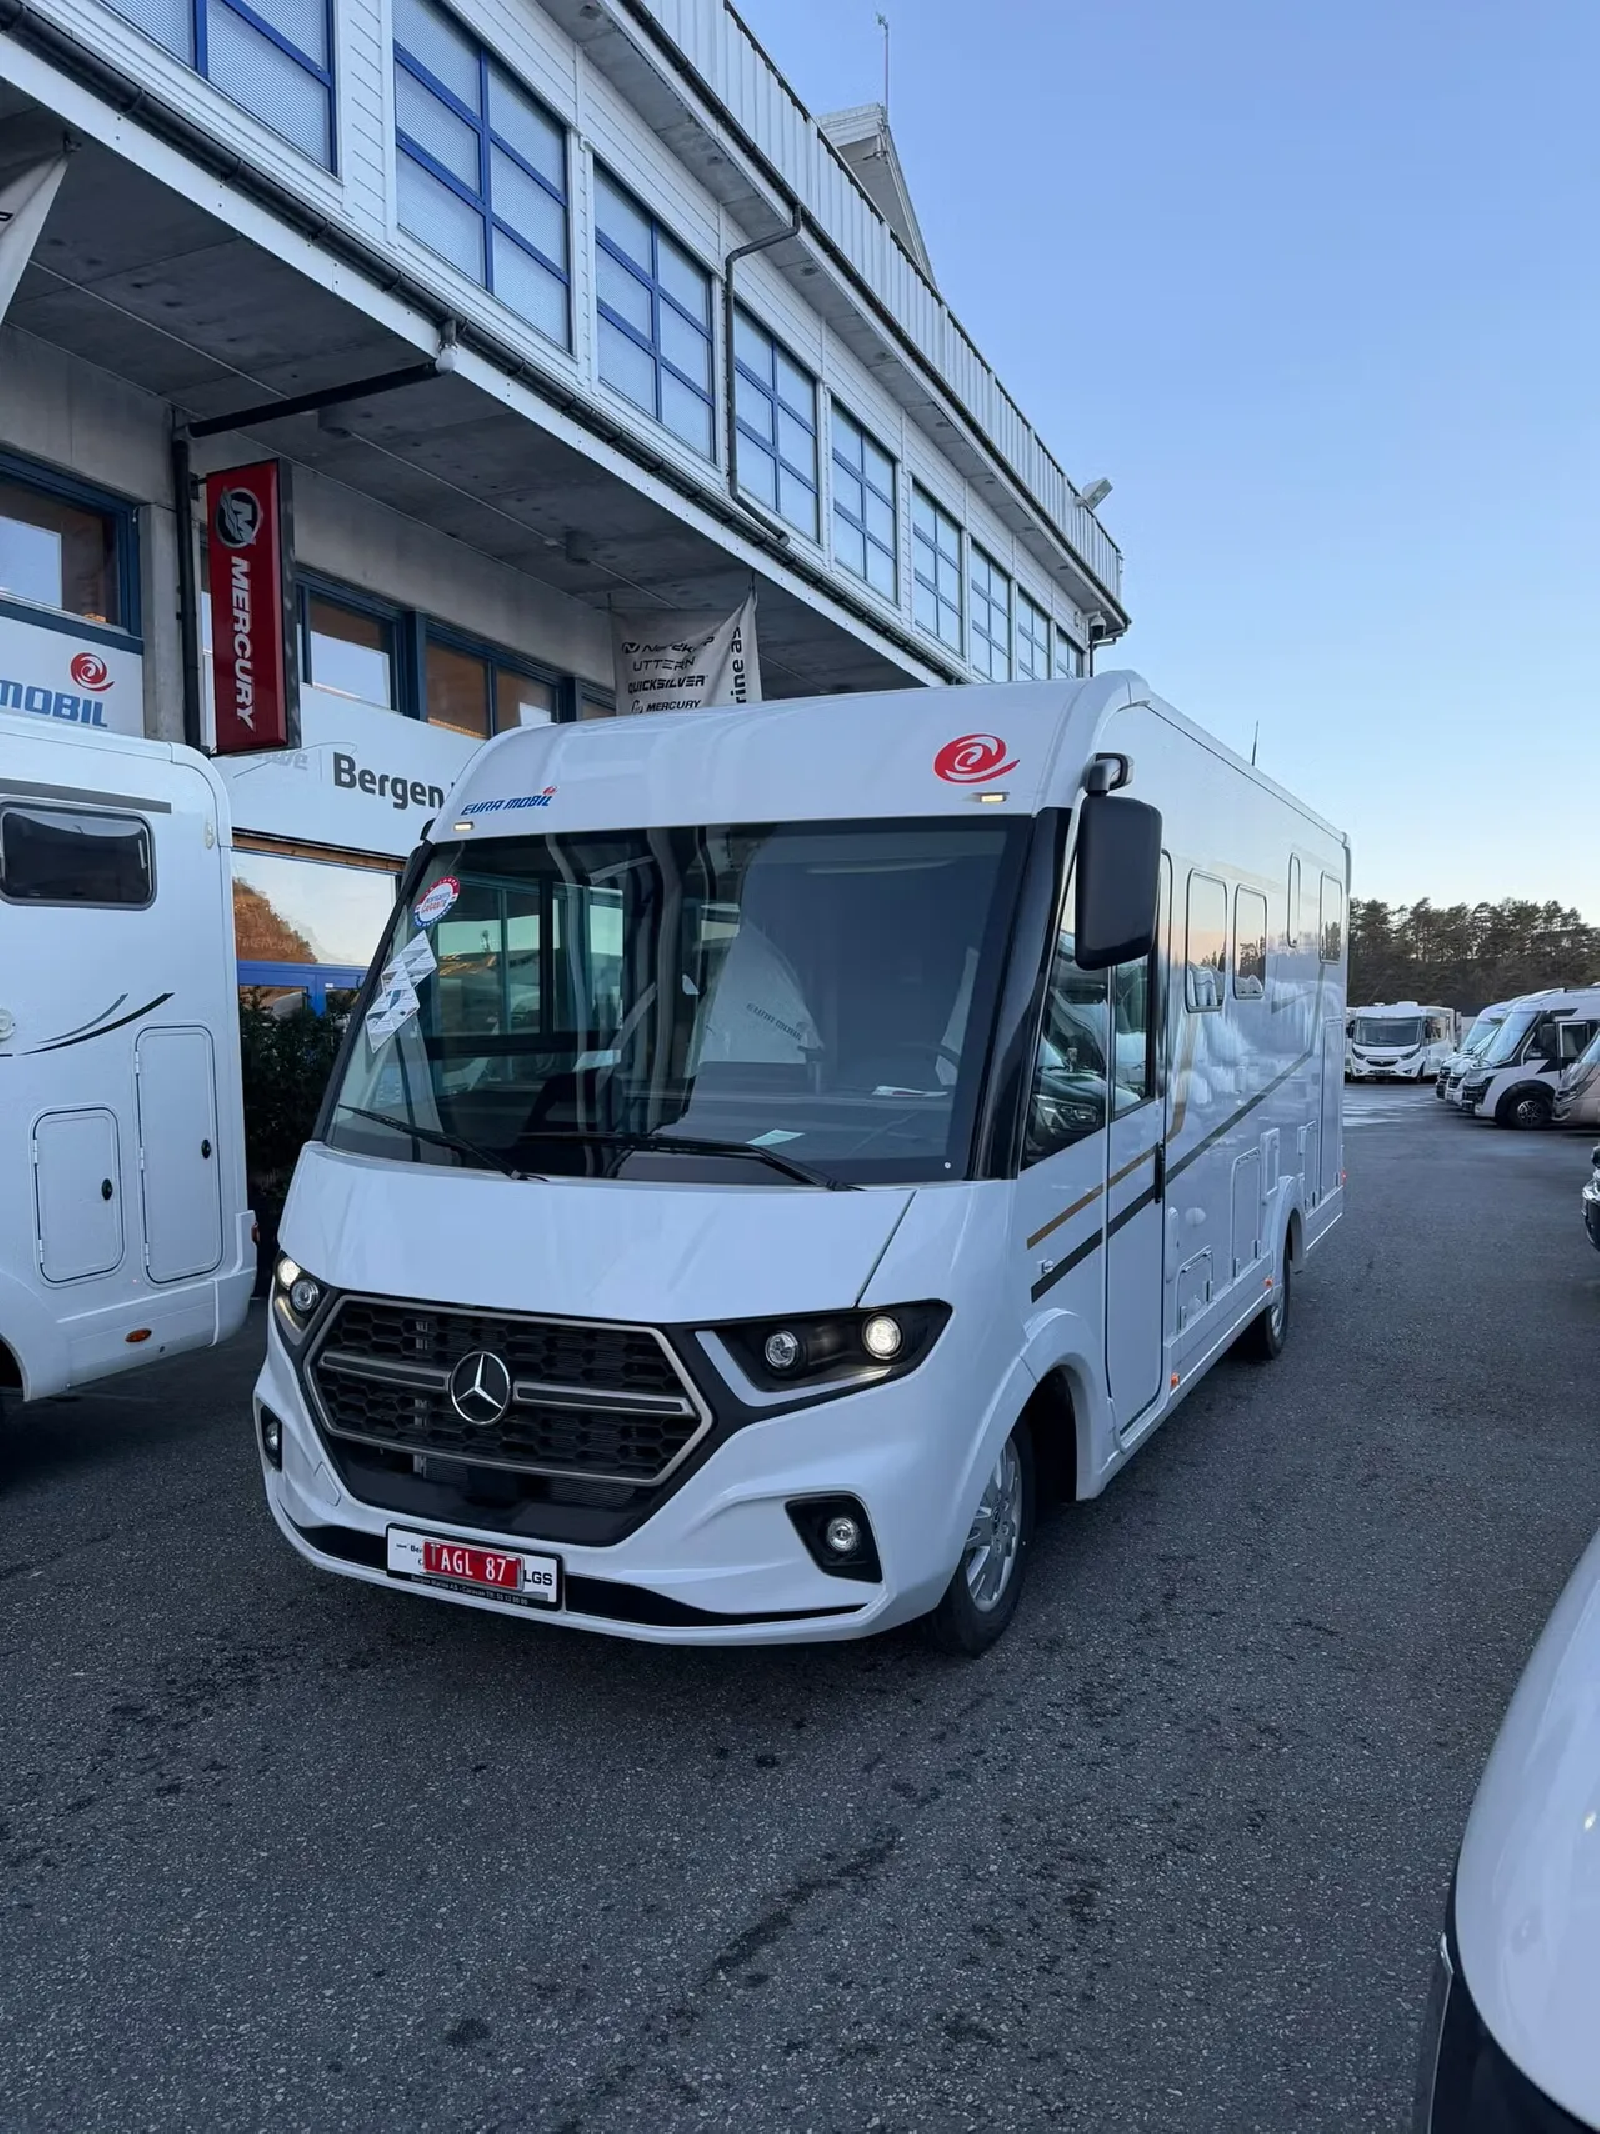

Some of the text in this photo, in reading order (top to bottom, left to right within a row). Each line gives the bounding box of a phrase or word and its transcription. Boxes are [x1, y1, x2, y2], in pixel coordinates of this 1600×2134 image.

[230, 556, 256, 732] MERCURY
[627, 675, 706, 694] QUICKSILVER
[646, 700, 702, 711] MERCURY
[332, 752, 444, 811] Bergen
[441, 1547, 506, 1582] AGL 87
